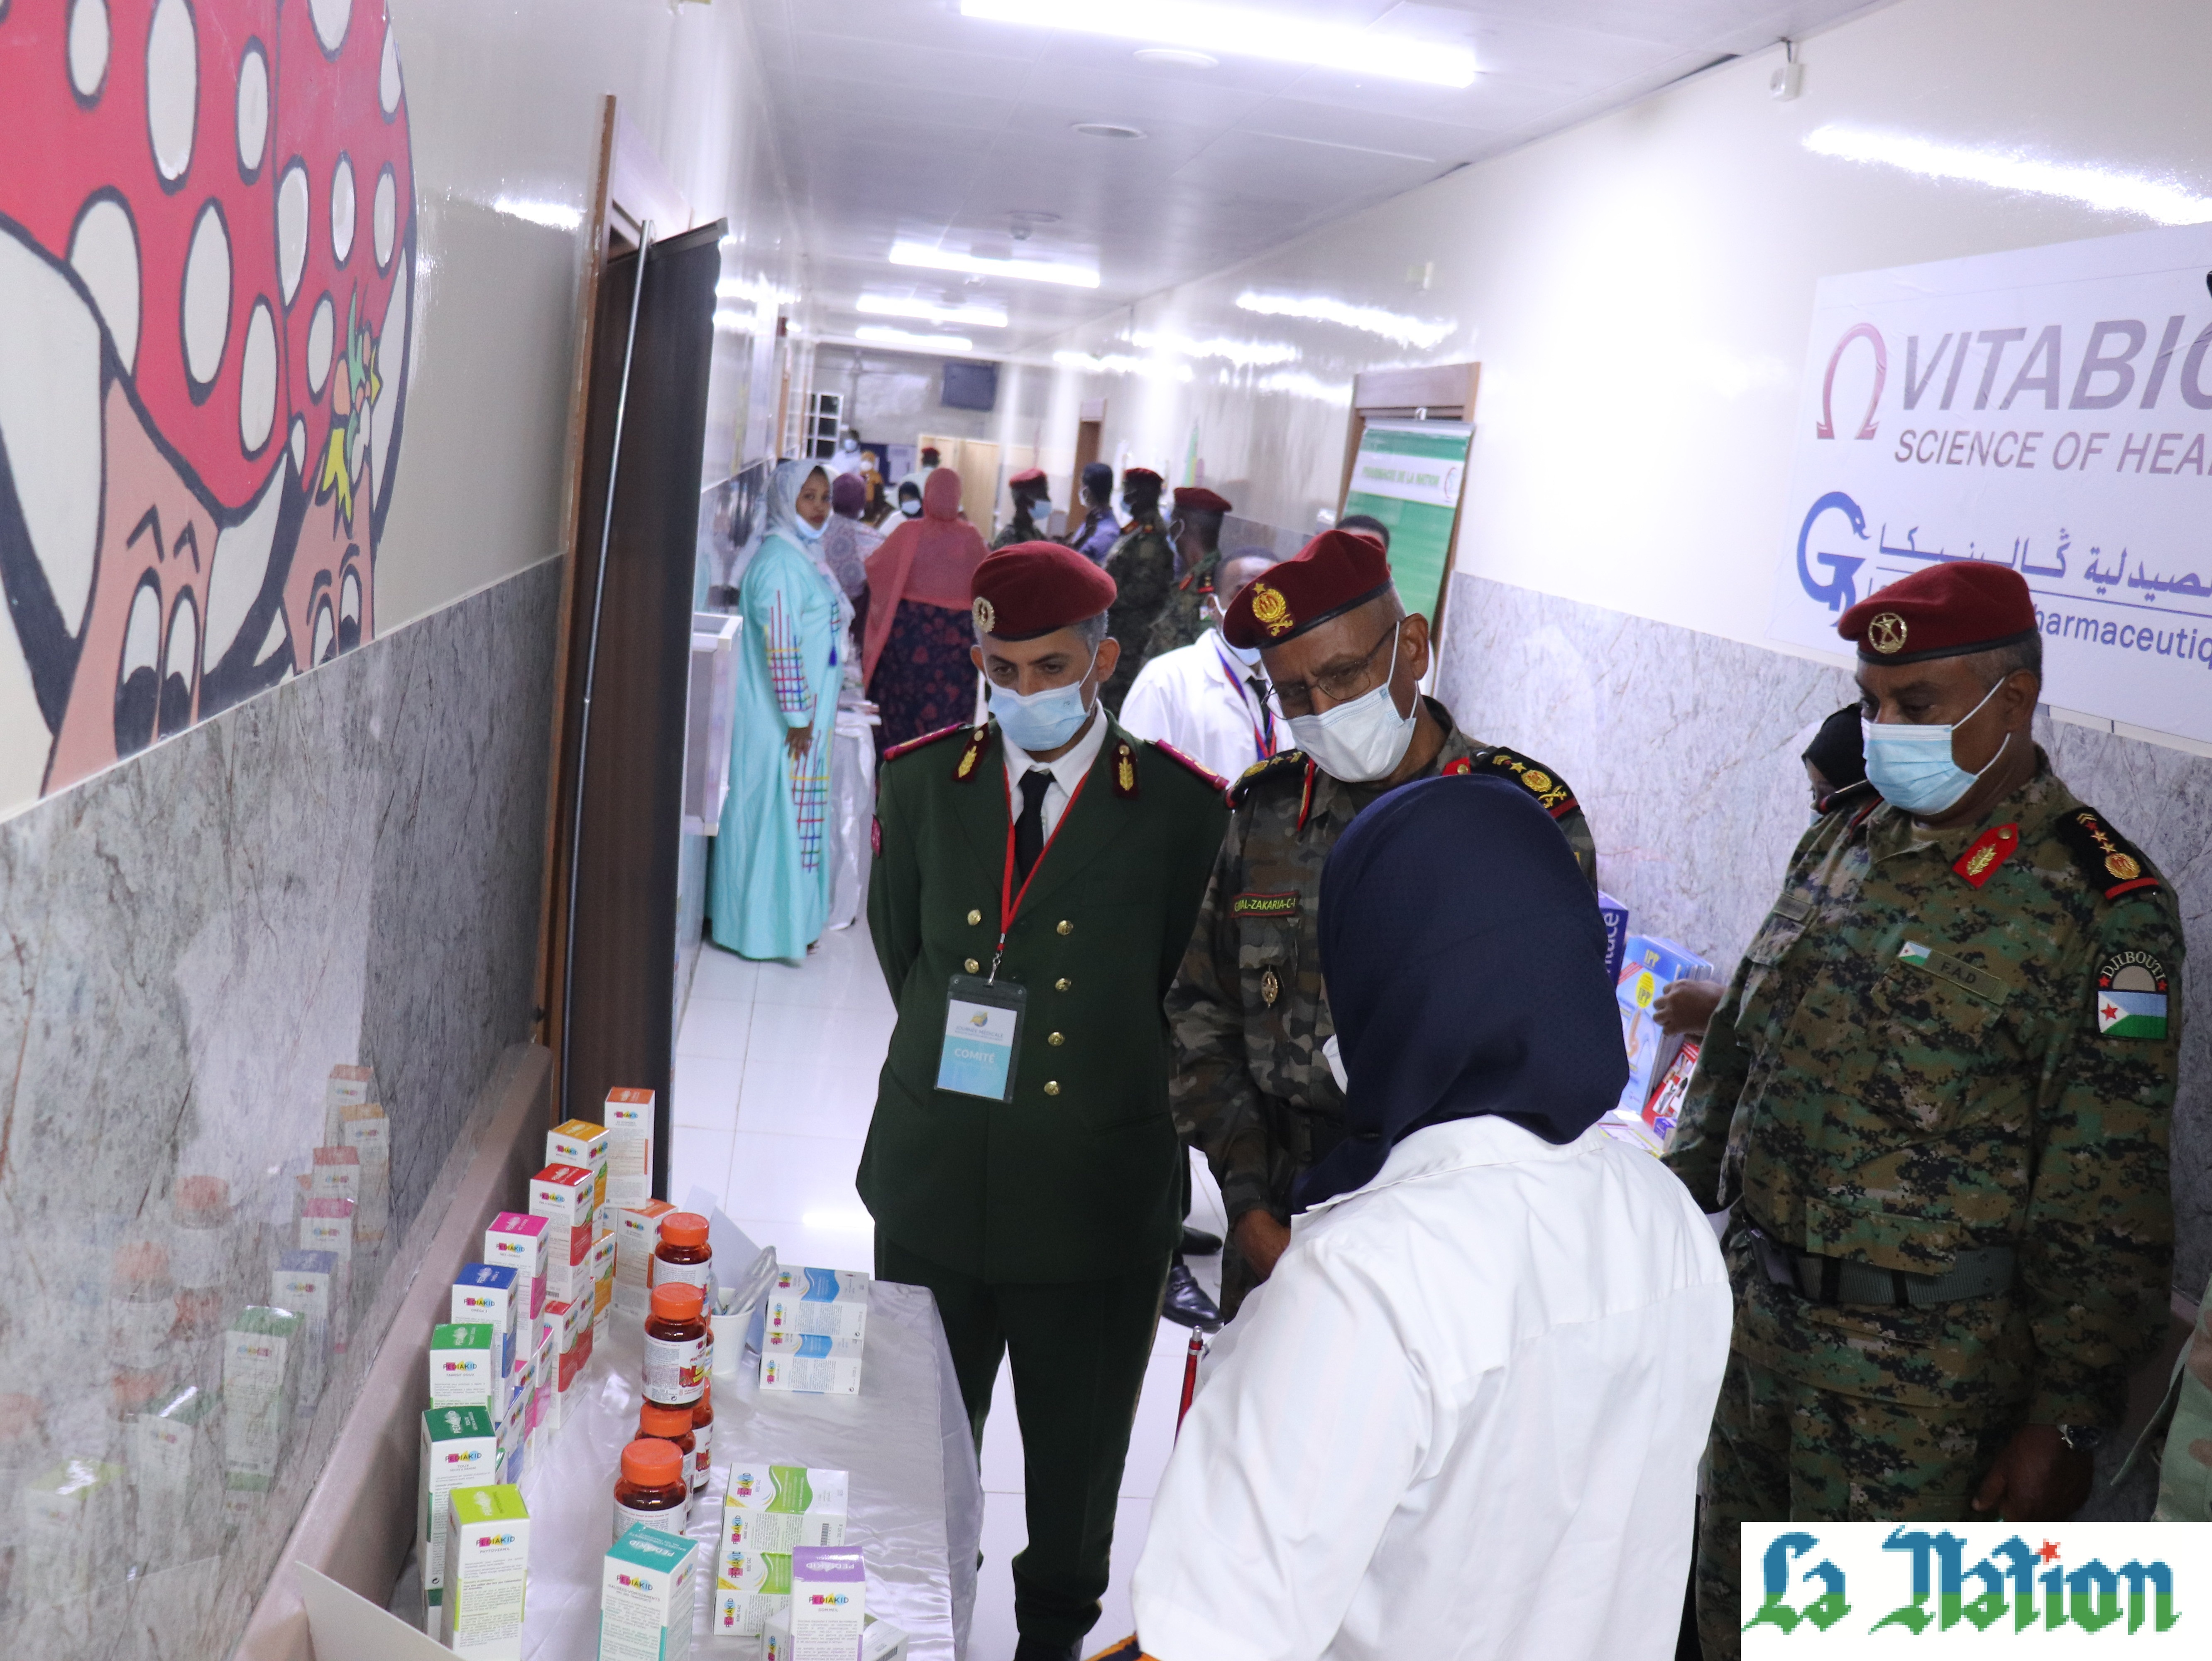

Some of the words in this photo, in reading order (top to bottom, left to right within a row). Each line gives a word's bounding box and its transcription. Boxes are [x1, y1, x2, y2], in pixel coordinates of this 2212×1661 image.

[1894, 429, 2043, 468] SCIENCE
[2052, 432, 2110, 470] OF
[2117, 432, 2212, 476] HEA
[2035, 604, 2212, 670] harmaceutiq
[2100, 951, 2166, 982] DJIBOUTI
[954, 1048, 996, 1063] COMITÉ
[496, 1243, 525, 1252] PEDIAKID
[464, 1298, 495, 1307] PEDIAKID
[445, 1453, 482, 1462] PEDIAKID
[739, 1472, 751, 1497] PEDIAKID
[733, 1515, 741, 1545] PEDIAKID
[476, 1536, 515, 1546] PEDIAKID
[629, 1539, 675, 1557] PEDIAKID
[617, 1575, 653, 1591] PEDIAKID
[809, 1596, 849, 1605] PEDIAKID
